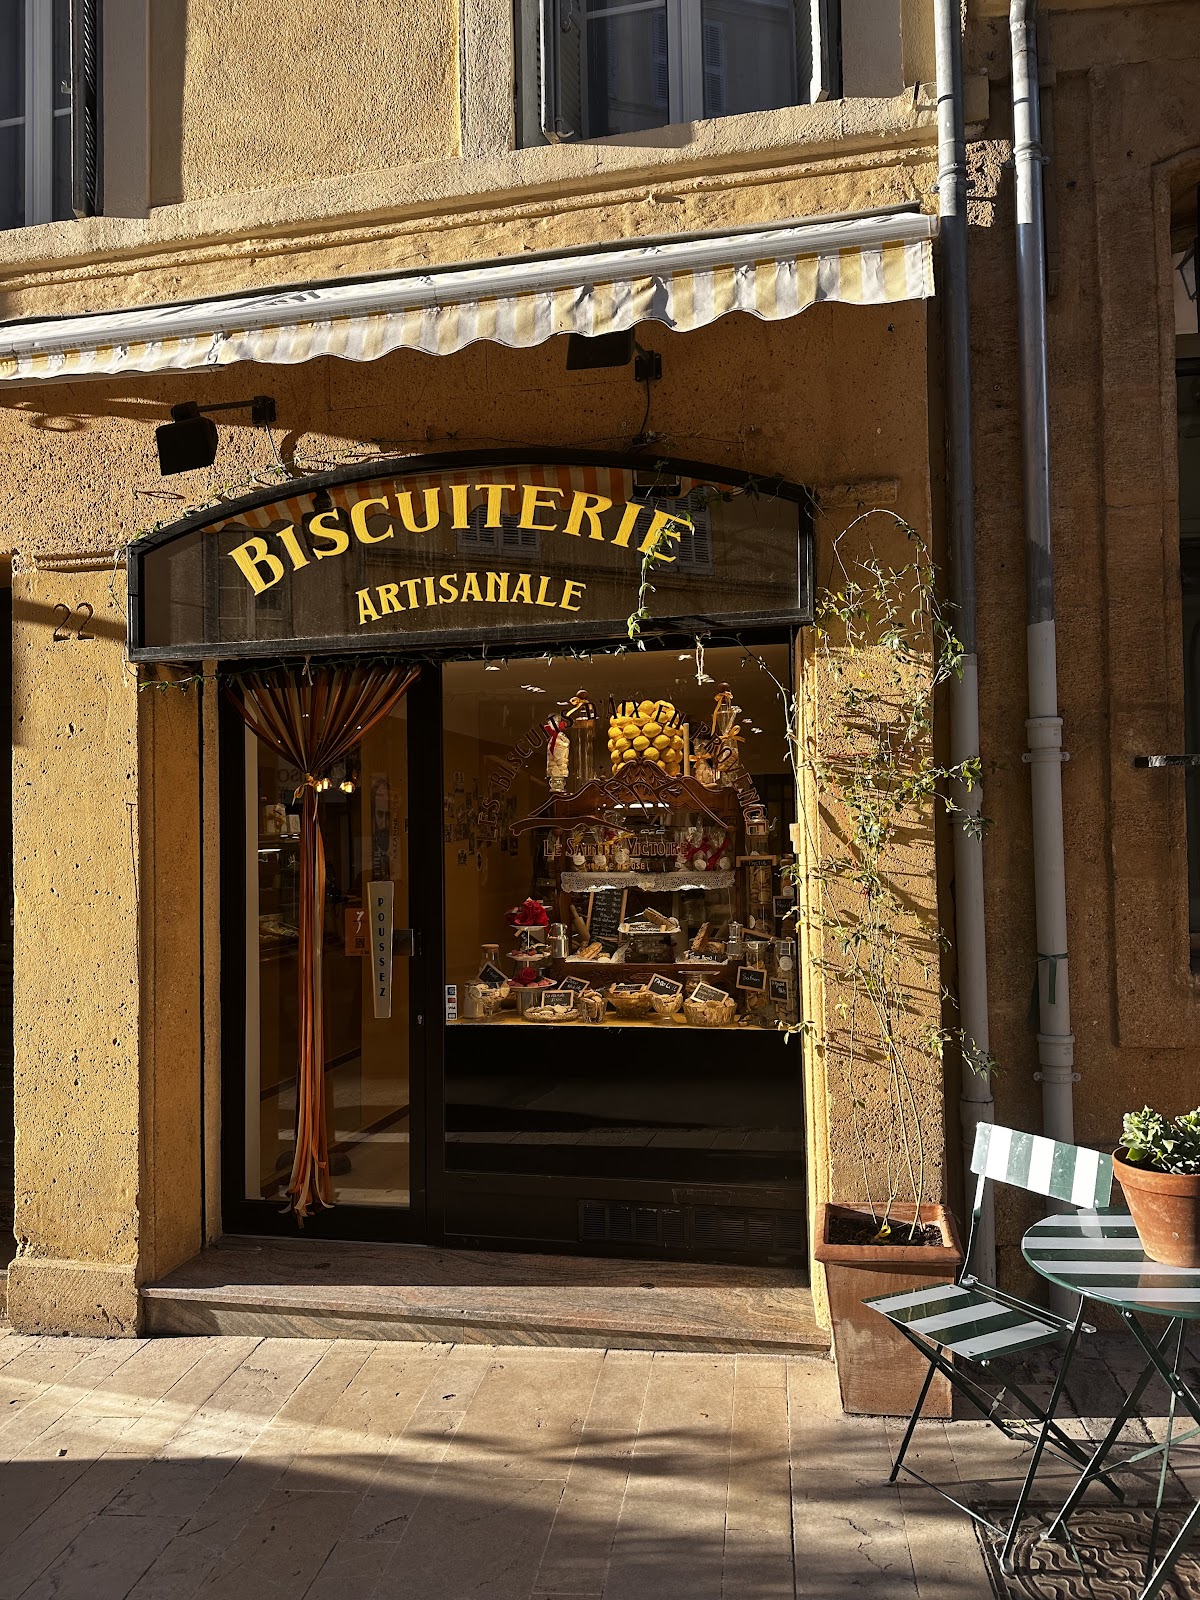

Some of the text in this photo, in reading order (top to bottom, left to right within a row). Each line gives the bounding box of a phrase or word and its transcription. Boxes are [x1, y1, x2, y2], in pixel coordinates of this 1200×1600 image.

[230, 485, 694, 593] BISCUITERIE
[52, 603, 94, 641] 22
[358, 573, 586, 624] ARTISANALE
[477, 798, 501, 842] LES
[490, 709, 574, 791] BISCUITS
[655, 704, 688, 730] EN
[689, 720, 769, 836] PROVENCE
[542, 839, 563, 857] LE
[626, 836, 690, 857] VICTOIRE
[377, 897, 387, 997] POUSSEZ
